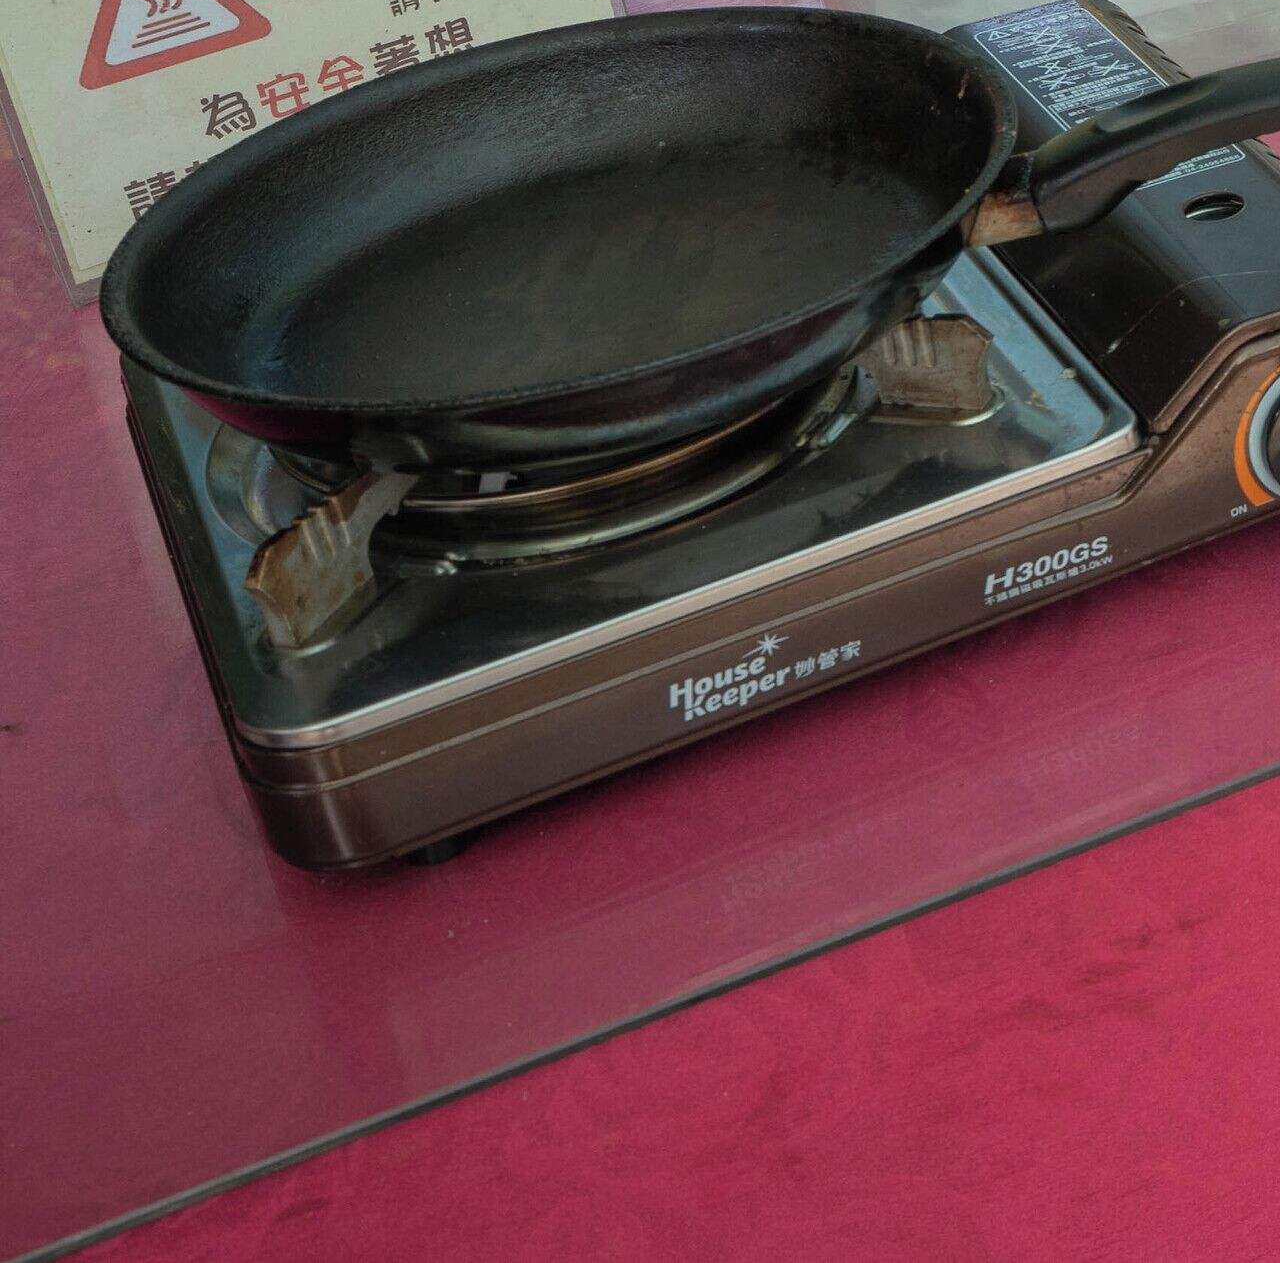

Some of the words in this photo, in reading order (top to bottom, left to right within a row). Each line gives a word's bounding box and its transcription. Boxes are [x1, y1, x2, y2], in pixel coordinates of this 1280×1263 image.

[1230, 504, 1248, 518] ON
[984, 536, 1108, 595] H300GS
[669, 656, 767, 710] House
[794, 639, 862, 680] 妙管家
[684, 666, 791, 722] Keeper
